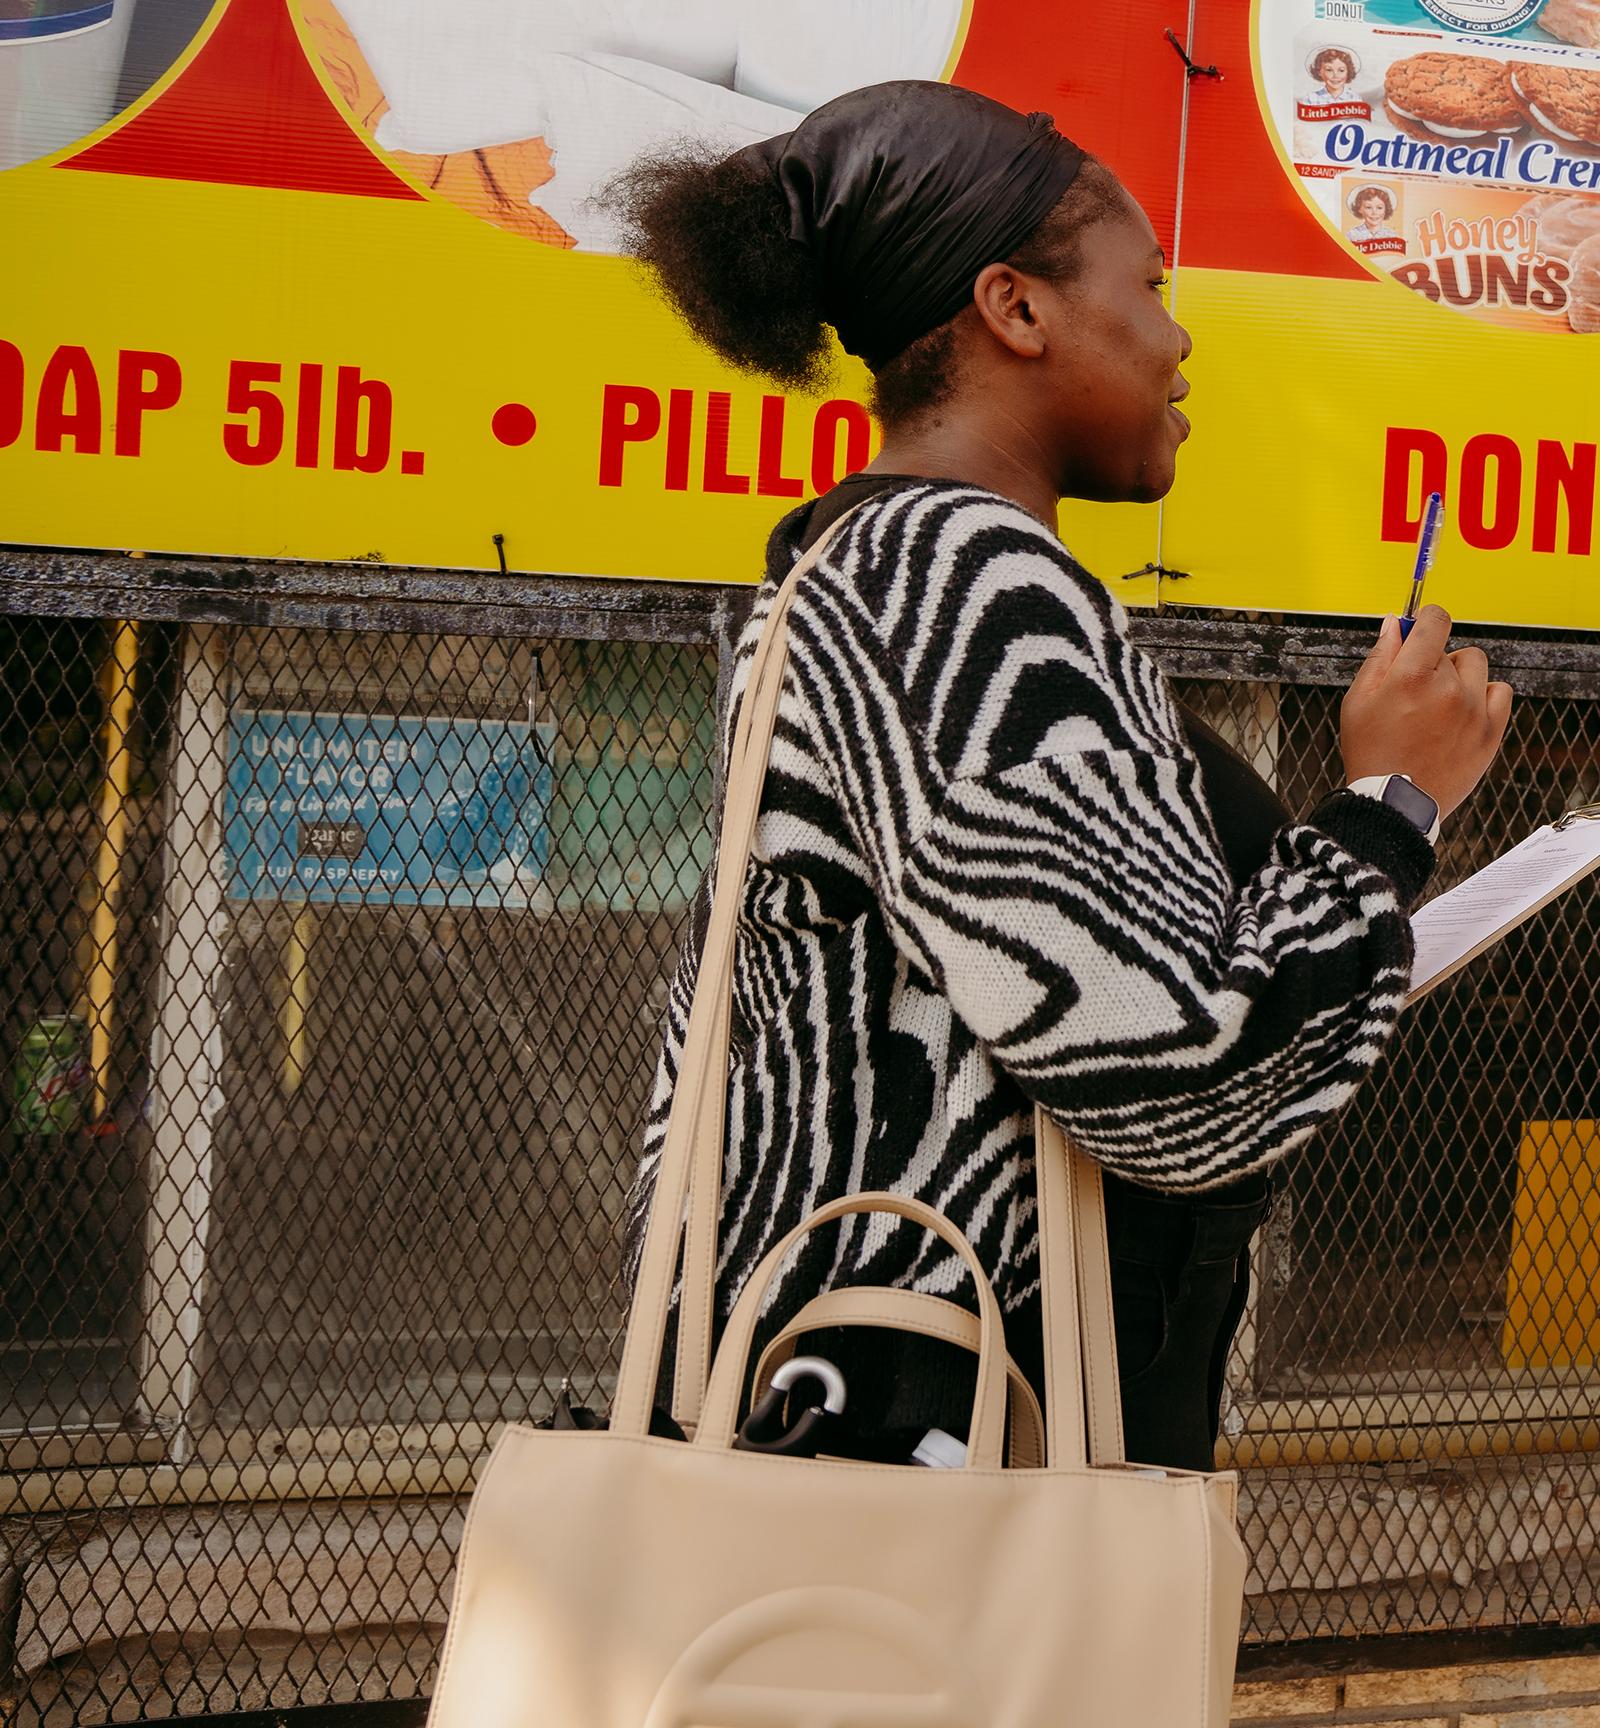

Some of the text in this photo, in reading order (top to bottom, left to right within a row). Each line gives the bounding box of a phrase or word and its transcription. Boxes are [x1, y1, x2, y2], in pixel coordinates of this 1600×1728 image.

[1326, 2, 1363, 20] DONUT
[1466, 22, 1488, 31] FOR
[1490, 7, 1531, 31] DIPPING!
[1300, 105, 1368, 118] Little Debbie
[1324, 122, 1512, 180] Oatmeal
[1369, 240, 1403, 251] Debbie
[1418, 210, 1547, 265] Honey
[1390, 253, 1571, 312] BUNS
[279, 761, 391, 788] FLAVOR
